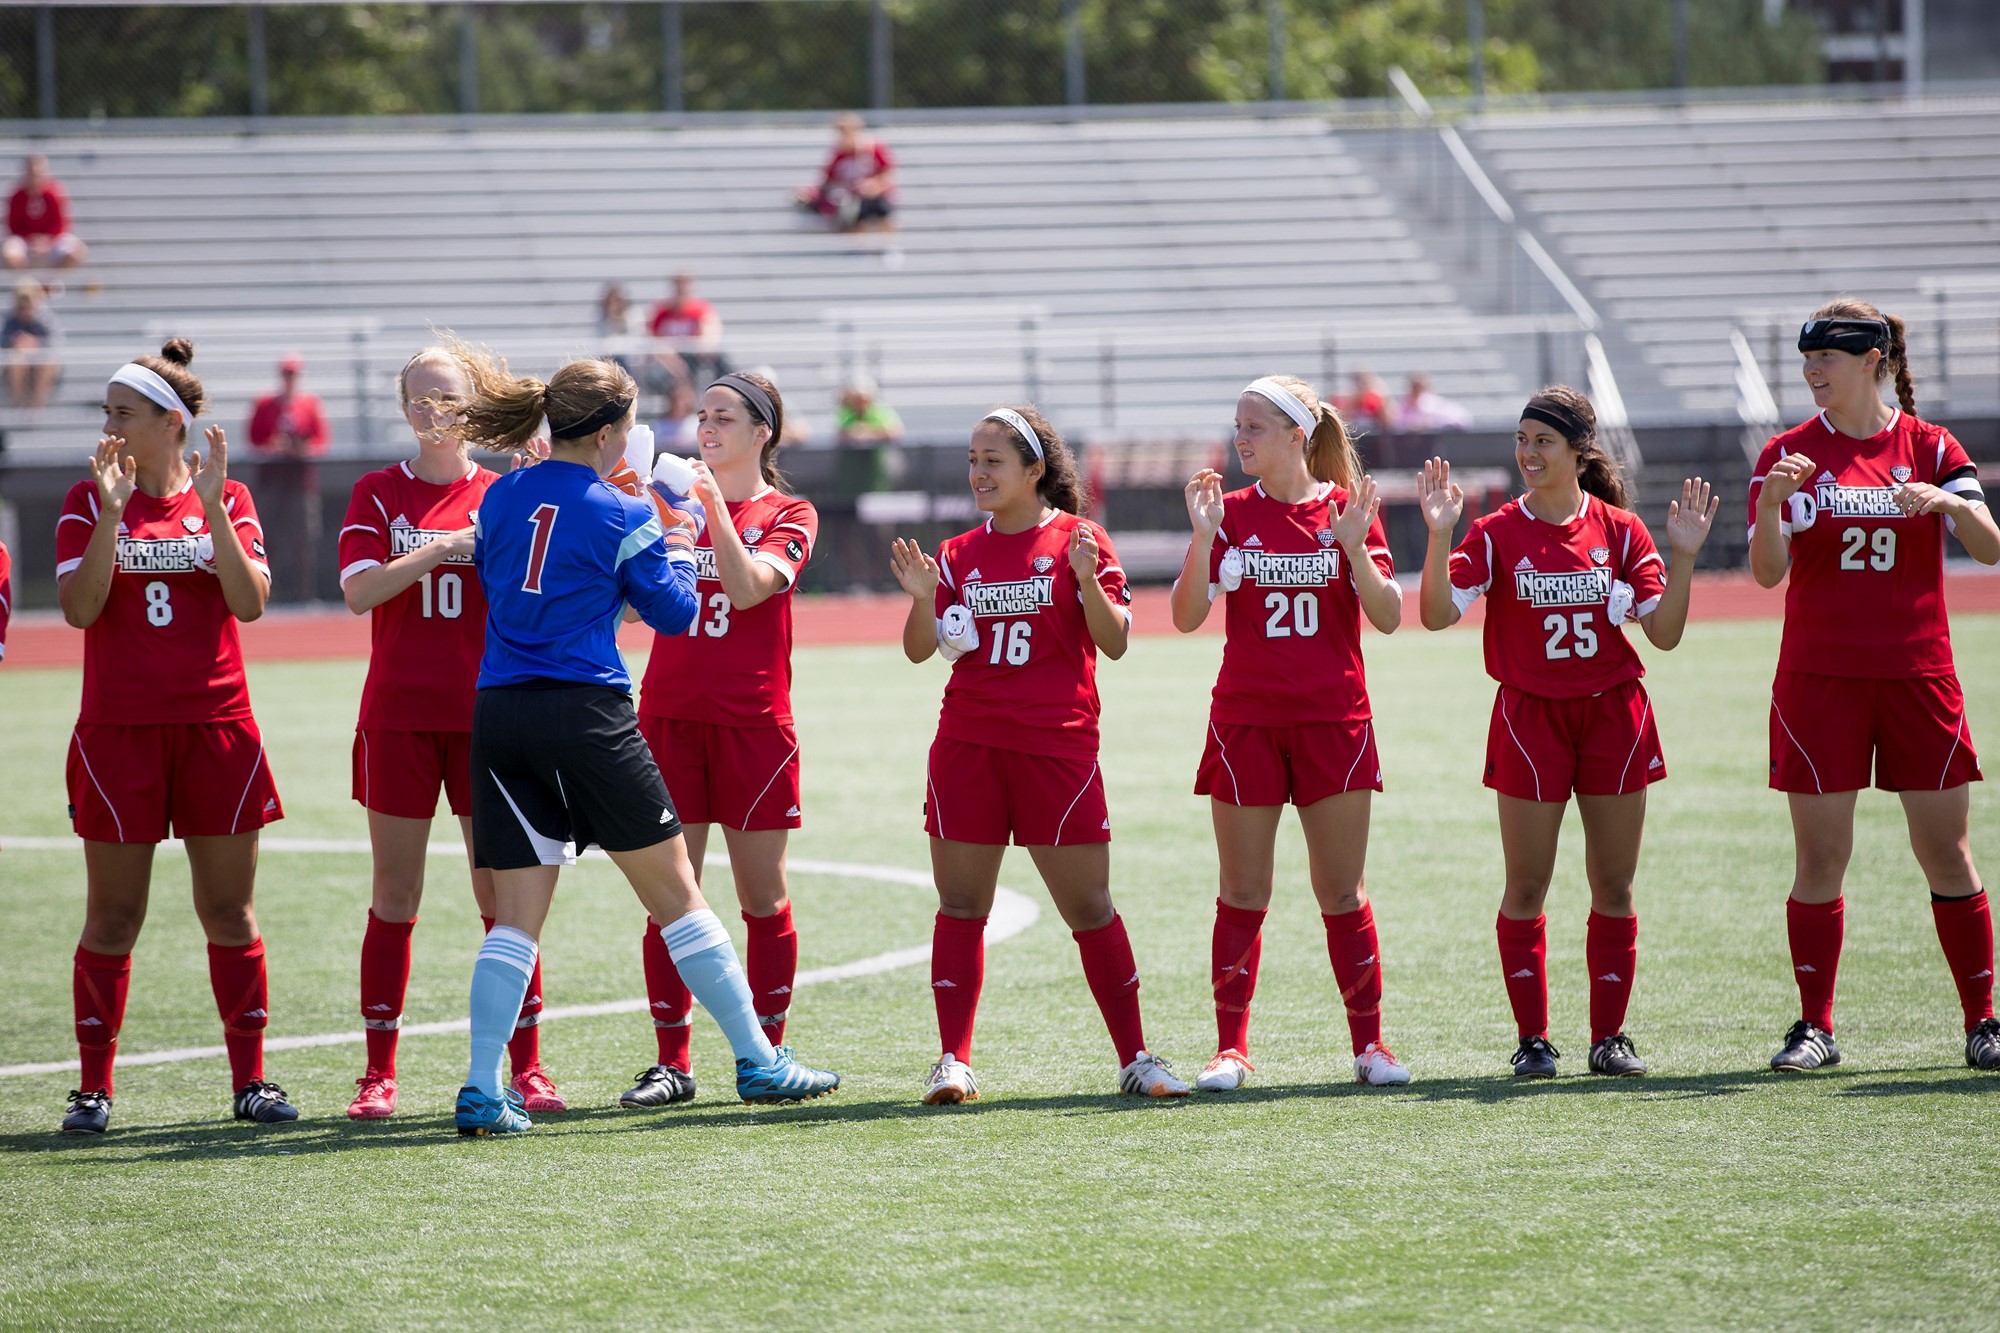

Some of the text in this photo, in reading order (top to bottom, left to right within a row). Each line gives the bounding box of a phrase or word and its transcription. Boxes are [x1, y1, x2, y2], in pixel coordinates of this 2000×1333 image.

[1835, 501, 1900, 515] ILLINOIS
[124, 556, 188, 571] ILLINOIS
[521, 503, 560, 595] 1
[1243, 550, 1338, 576] NORTHERN
[1840, 527, 1897, 572] 29
[964, 578, 1051, 608] NORTHERN
[1259, 571, 1324, 585] ILLINOIS
[1517, 569, 1611, 597] NORTHERN
[144, 581, 174, 628] 8
[417, 572, 463, 619] 10
[976, 600, 1036, 615] ILLINOIS
[1534, 589, 1599, 605] ILLINOIS
[1264, 591, 1319, 638] 20
[989, 620, 1032, 666] 16
[1543, 612, 1599, 660] 25
